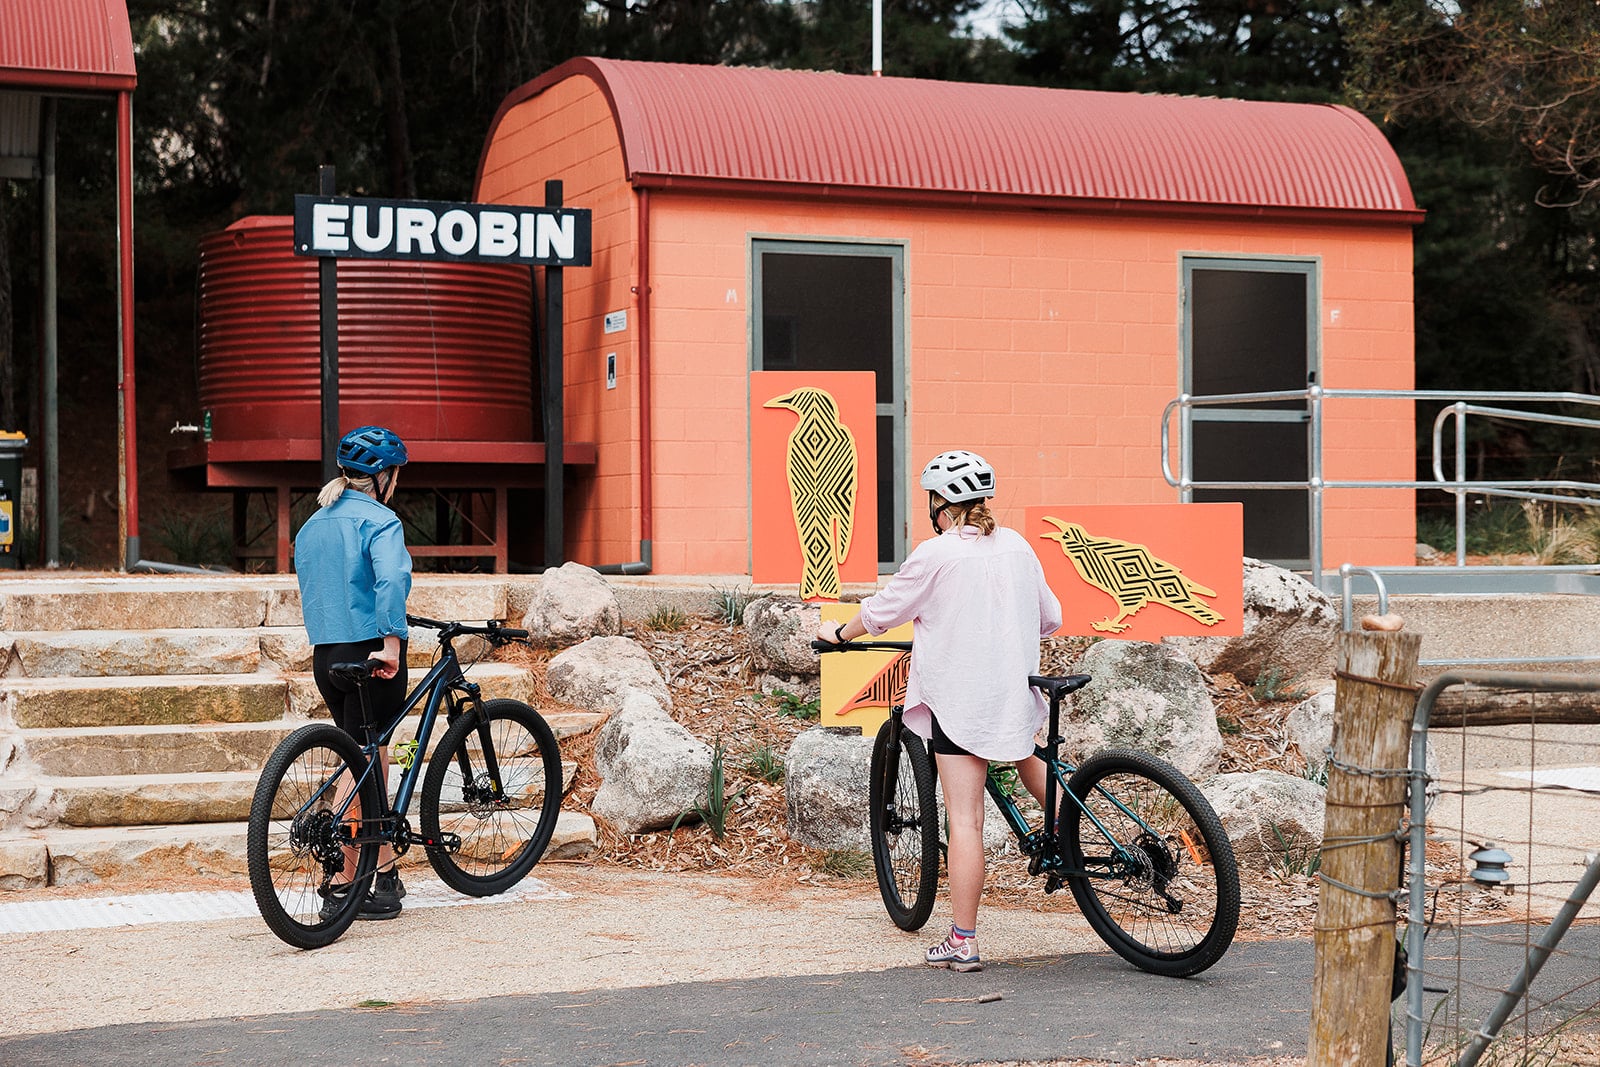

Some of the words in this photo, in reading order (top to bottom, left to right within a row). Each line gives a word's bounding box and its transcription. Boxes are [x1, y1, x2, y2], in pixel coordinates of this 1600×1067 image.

[313, 203, 575, 259] EUROBIN
[726, 288, 738, 303] M
[1330, 309, 1341, 324] F
